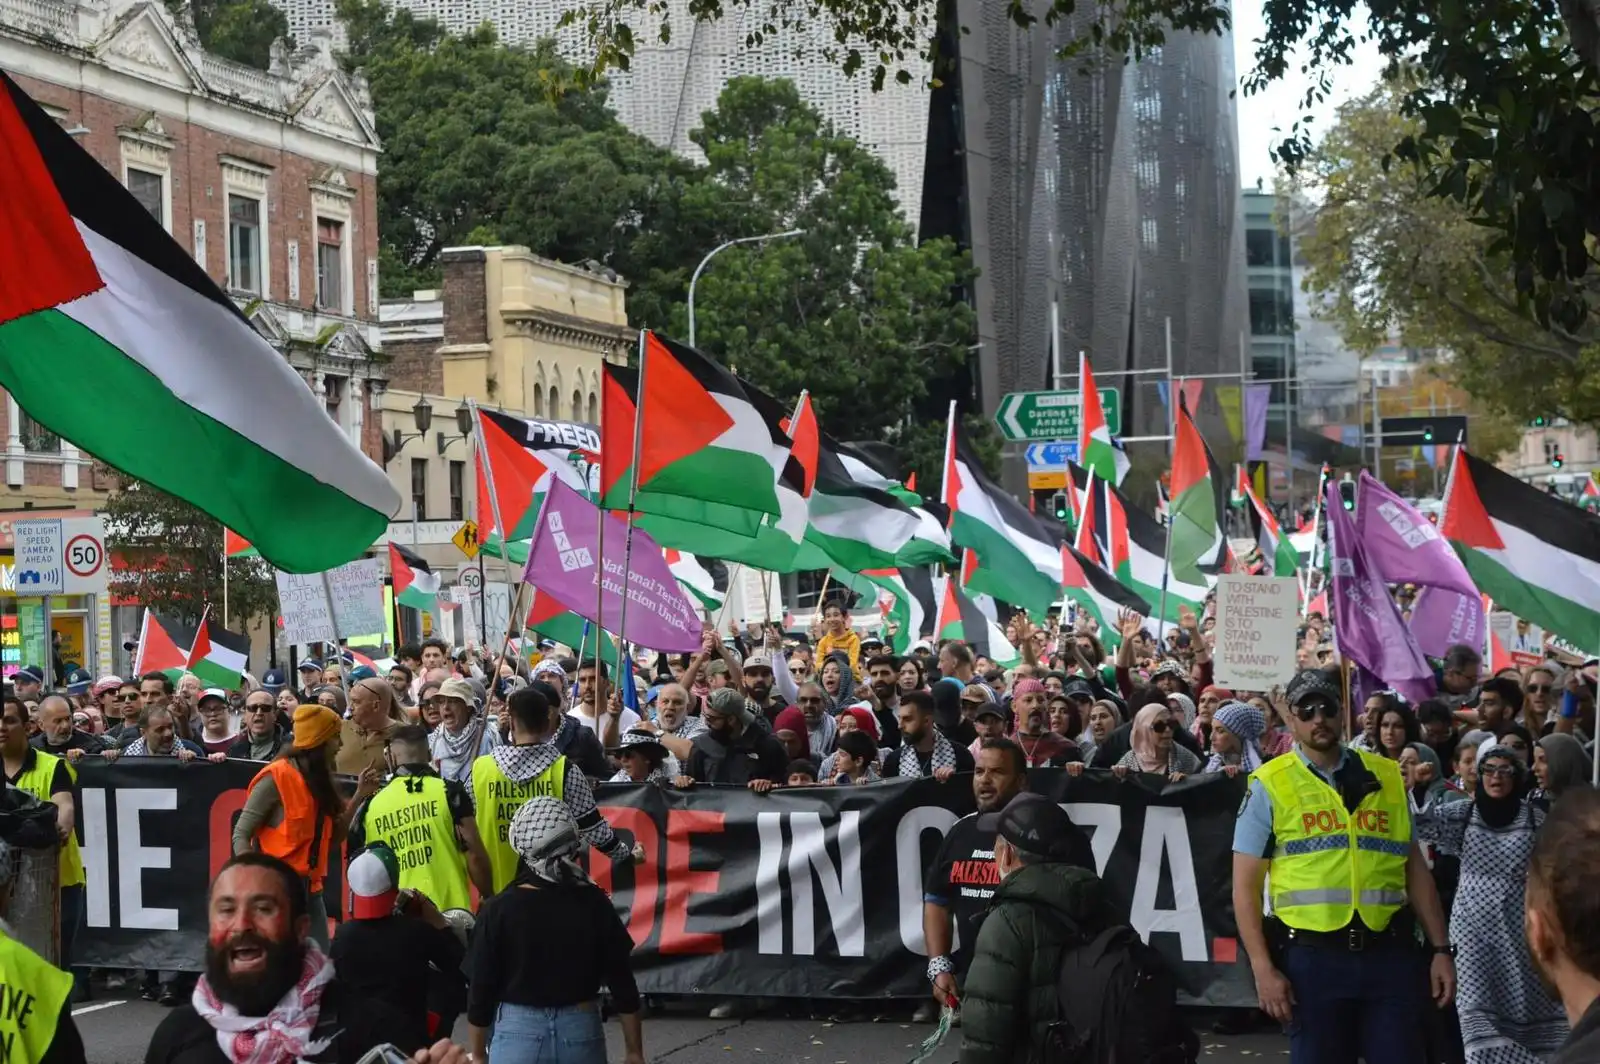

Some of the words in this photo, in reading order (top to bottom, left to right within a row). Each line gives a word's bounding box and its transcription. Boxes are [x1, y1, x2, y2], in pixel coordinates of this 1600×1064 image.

[1028, 409, 1067, 419] Darling
[1036, 418, 1070, 427] Anzac
[525, 420, 600, 453] FREED
[1031, 427, 1073, 436] Harbour
[17, 527, 33, 536] RED
[36, 526, 58, 535] LIGHT
[26, 536, 51, 545] SPEED
[22, 546, 55, 555] CAMERA
[72, 546, 97, 565] 50
[25, 555, 52, 564] AHEAD
[287, 574, 311, 588] ALL
[464, 574, 480, 588] 50
[1225, 581, 1243, 593] TO
[1243, 582, 1281, 594] STAND
[280, 585, 328, 602] SYSTEMS
[1226, 593, 1254, 605] WITH
[296, 601, 307, 611] OF
[656, 583, 690, 622] Tertia
[1225, 605, 1282, 619] PALESTINE
[1225, 618, 1235, 628] IS
[1237, 618, 1252, 629] TO
[1225, 629, 1262, 641] STAND
[1224, 641, 1254, 653] WITH
[1224, 653, 1279, 666] HUMANITY
[488, 780, 553, 799] PALESTINE
[375, 800, 438, 836] PALESTINE
[497, 803, 521, 820] ACT
[1302, 808, 1389, 836] POLICE
[389, 823, 433, 850] ACTION
[950, 861, 1000, 884] PALESTI
[756, 810, 865, 957] IN
[960, 886, 981, 898] Never
